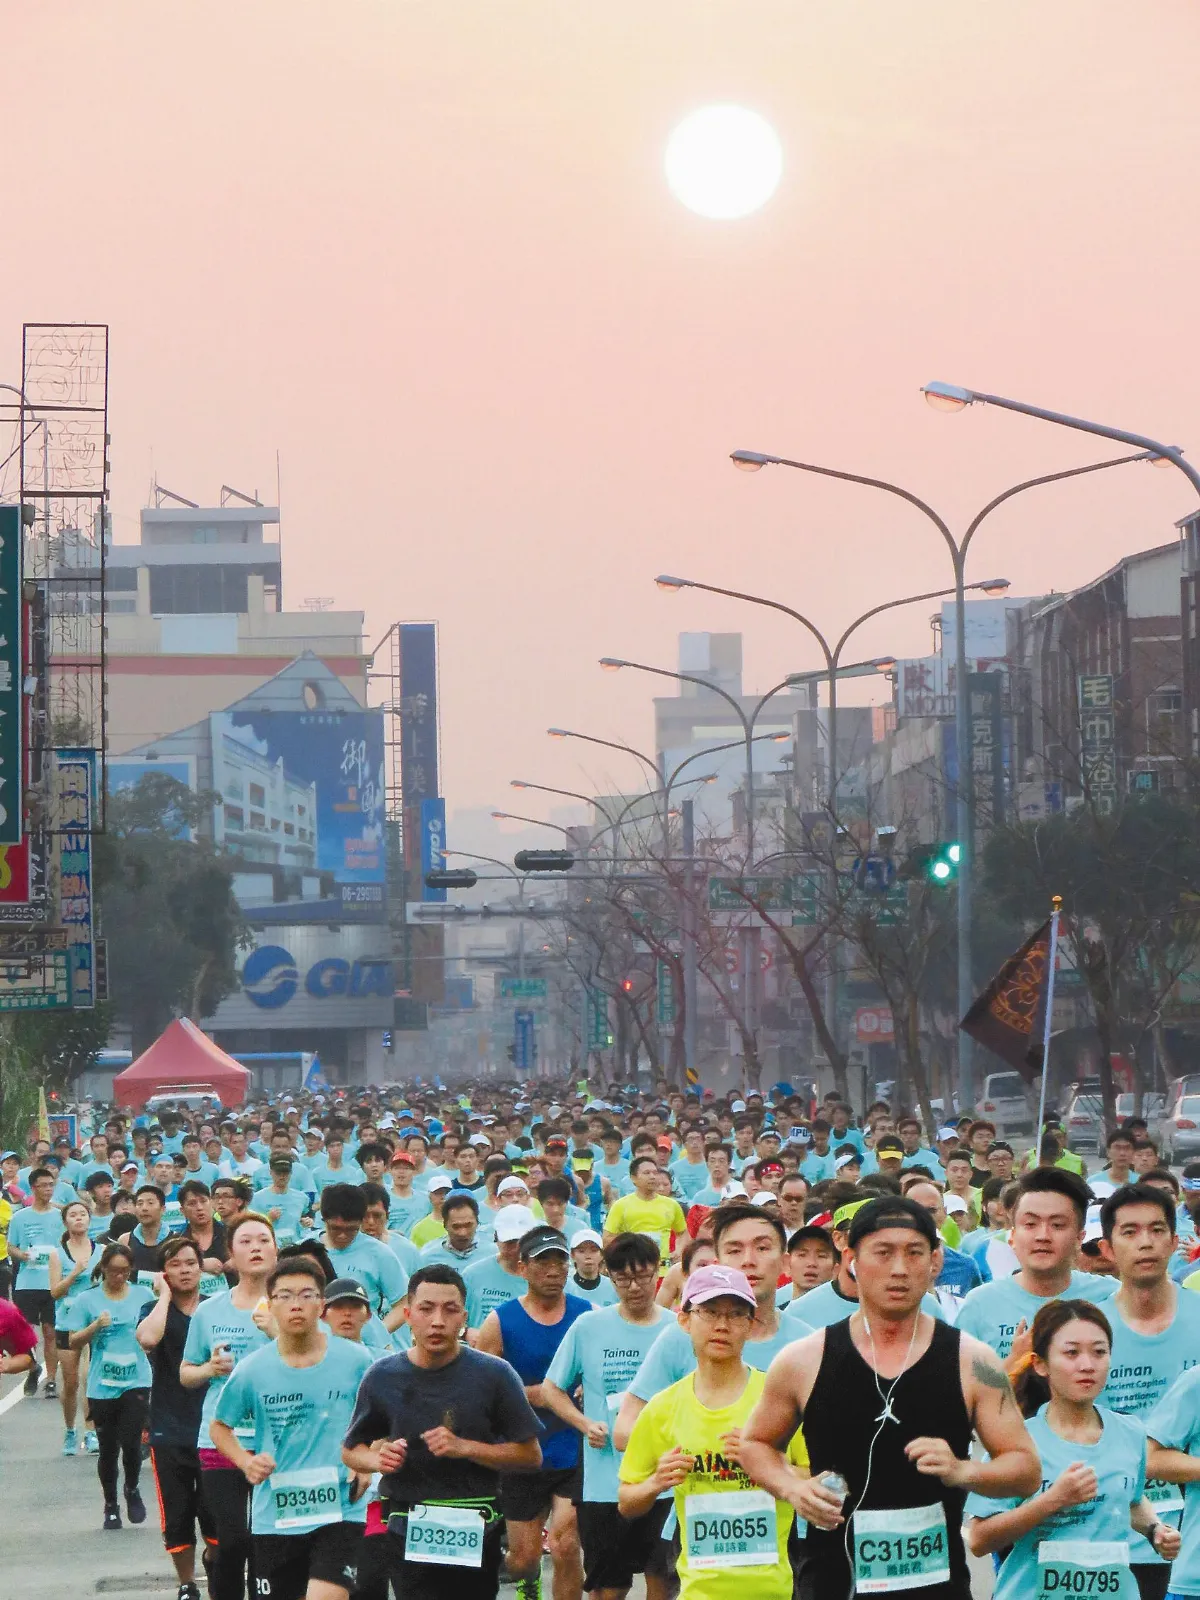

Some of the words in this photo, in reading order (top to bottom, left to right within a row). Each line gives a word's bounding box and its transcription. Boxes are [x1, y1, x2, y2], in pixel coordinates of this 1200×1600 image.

[200, 1277, 226, 1290] 33070
[482, 1288, 512, 1299] Tainan
[212, 1325, 245, 1334] Tainan
[603, 1348, 640, 1359] Tainan
[1109, 1365, 1152, 1379] ainan
[1105, 1382, 1135, 1392] Ancient
[1136, 1377, 1167, 1389] Capital
[263, 1392, 303, 1405] Tainan
[276, 1487, 337, 1508] D33460
[694, 1517, 768, 1541] D40655
[410, 1526, 478, 1548] D33238
[860, 1532, 944, 1563] C31564
[1044, 1568, 1120, 1593] D40795
